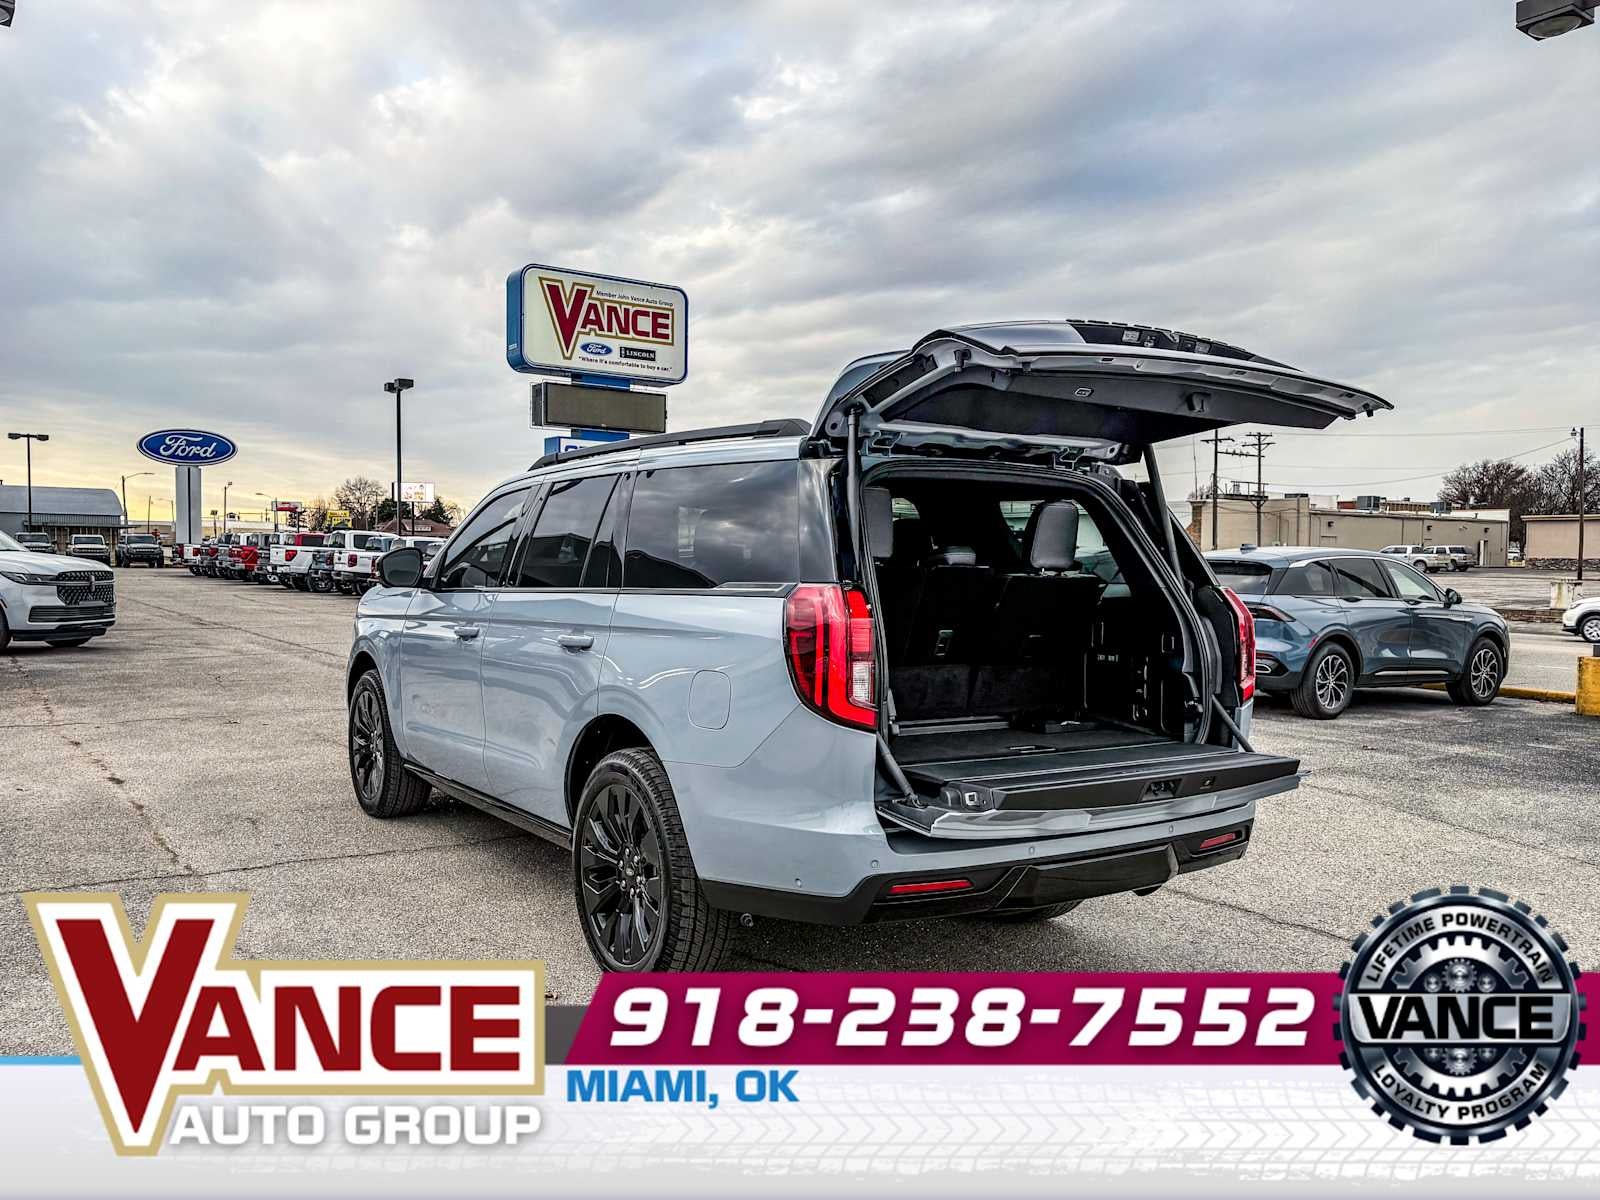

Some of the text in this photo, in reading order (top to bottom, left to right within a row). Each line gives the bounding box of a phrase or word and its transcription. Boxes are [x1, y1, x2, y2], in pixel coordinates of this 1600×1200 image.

[596, 290, 617, 298] Member
[646, 297, 658, 305] Auto
[658, 299, 673, 307] Group
[546, 284, 670, 354] VANCE
[586, 343, 607, 354] Ford
[626, 350, 655, 359] LINCOLN
[608, 360, 639, 368] comfortable
[646, 363, 656, 371] buy
[160, 434, 217, 458] Ford
